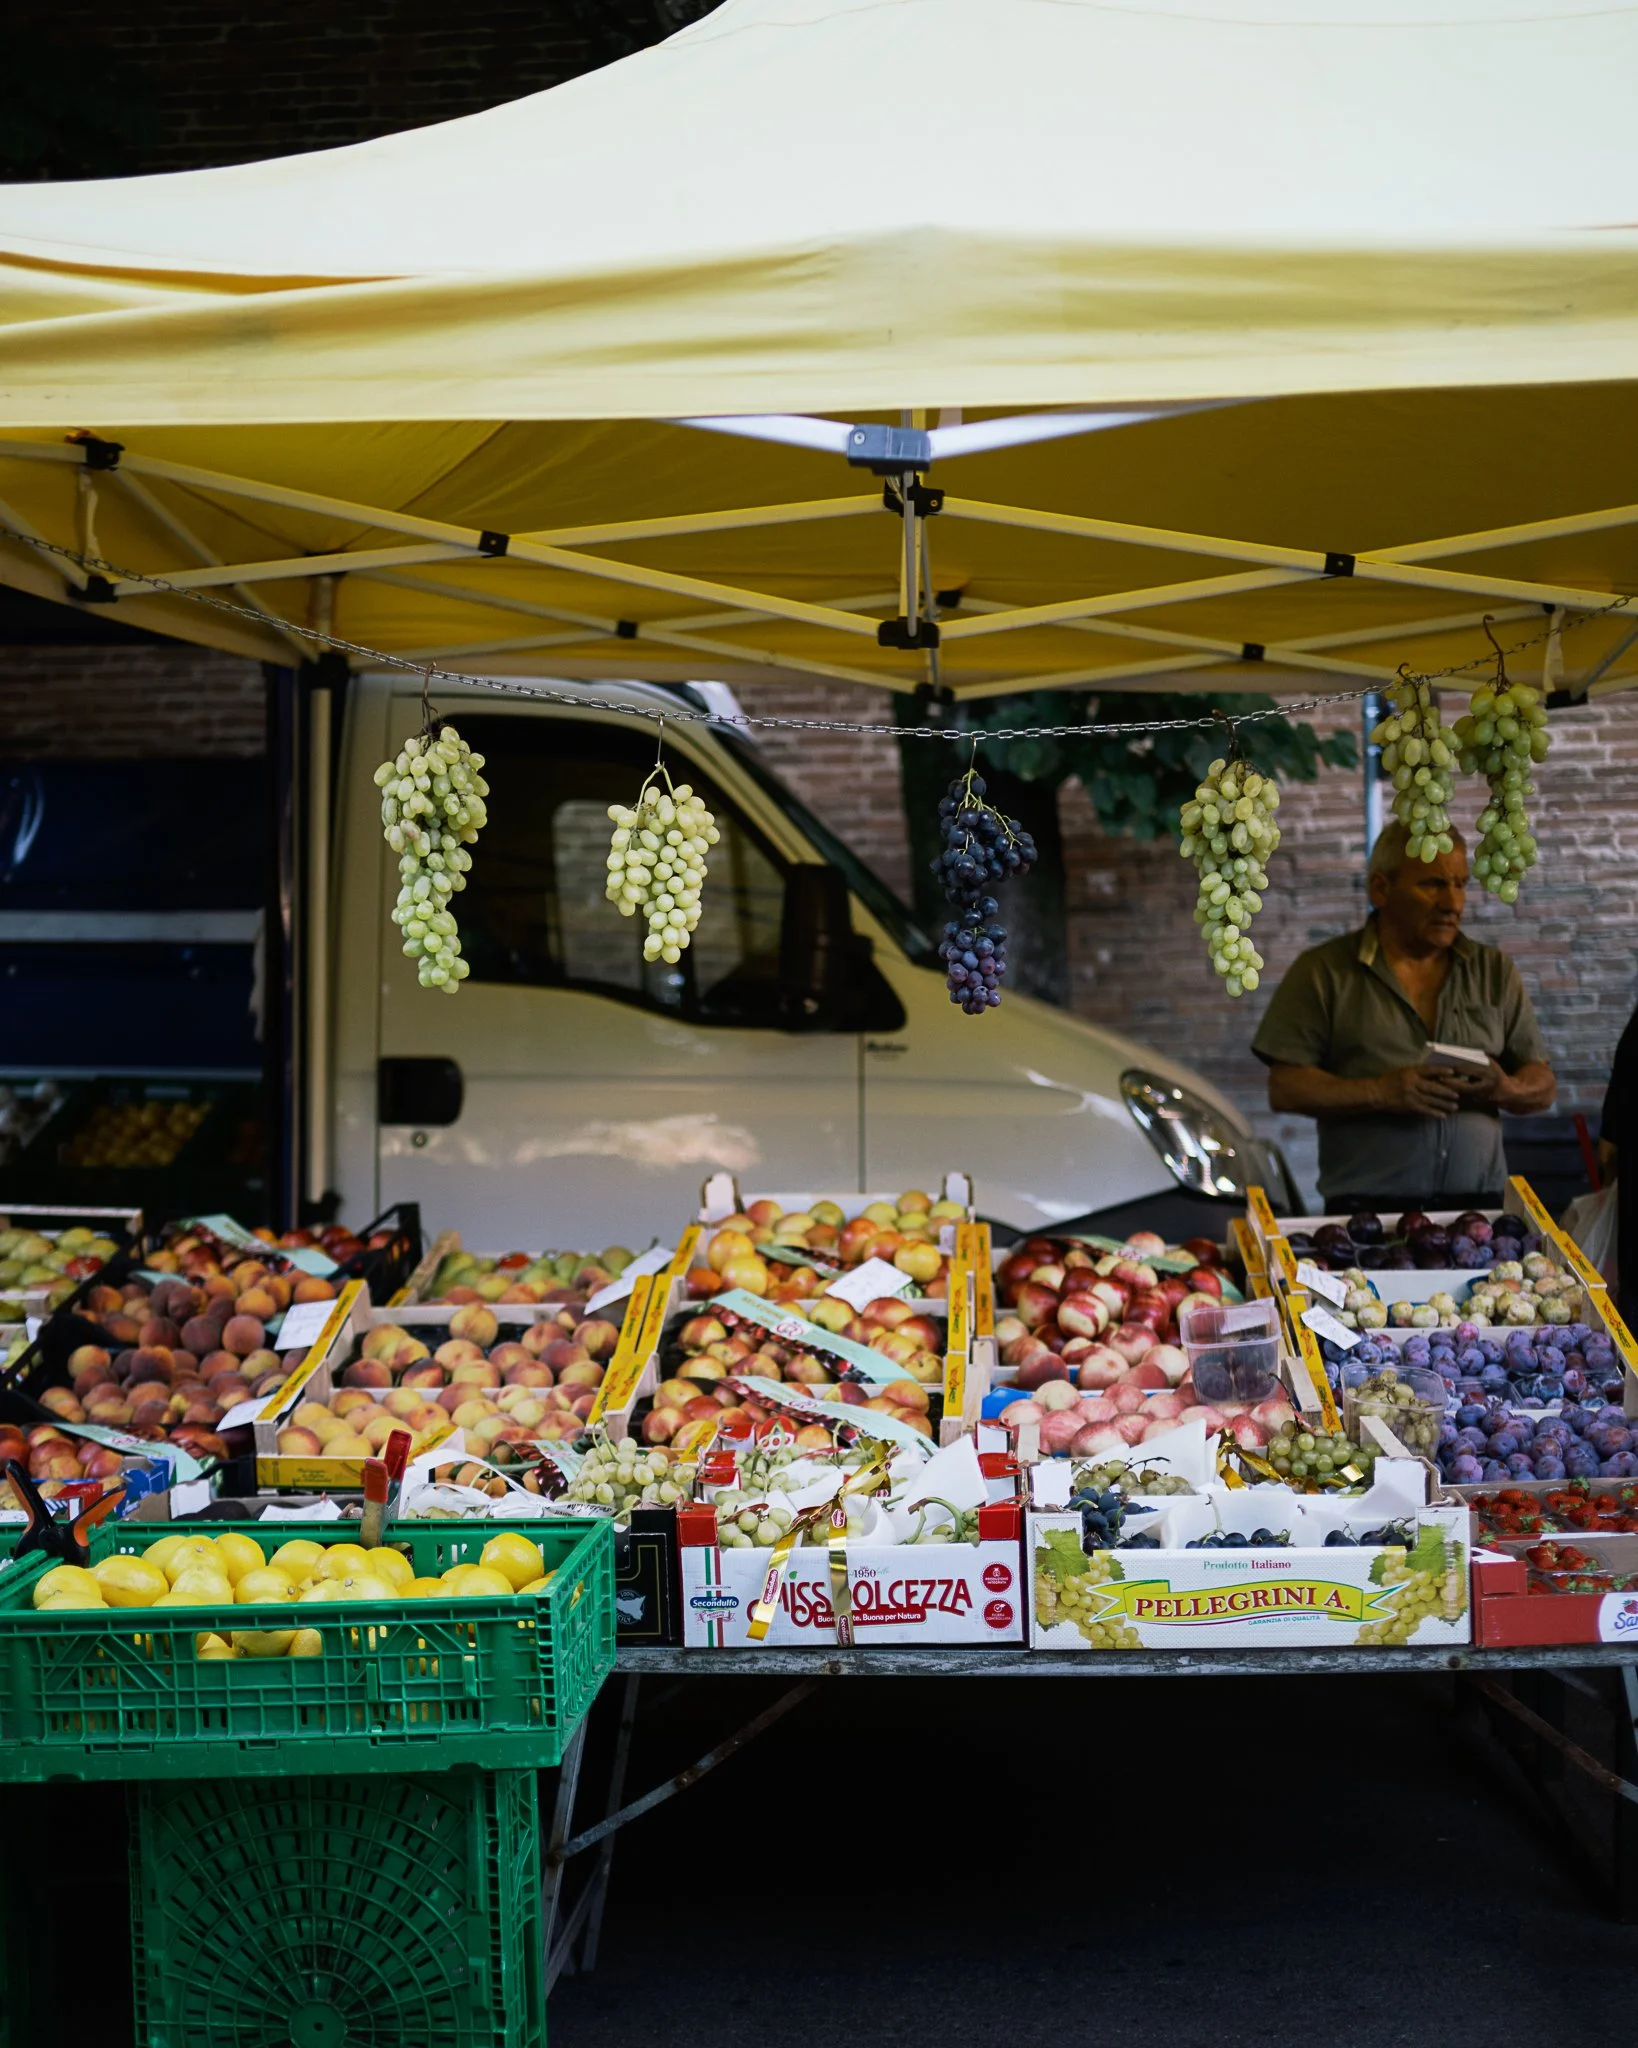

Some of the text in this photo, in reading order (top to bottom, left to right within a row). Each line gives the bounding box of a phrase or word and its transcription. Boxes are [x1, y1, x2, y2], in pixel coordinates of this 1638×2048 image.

[1203, 1559, 1292, 1570] Prodotto Italiano
[854, 1569, 876, 1578] 1950
[692, 1598, 737, 1607] Secondulfo
[849, 1579, 973, 1617] OLCEZZA
[1134, 1586, 1351, 1618] PELLEGRINI A.
[817, 1615, 835, 1623] Buon
[885, 1614, 896, 1623] per
[897, 1612, 921, 1620] Natura
[1248, 1617, 1282, 1626] GARANZIA
